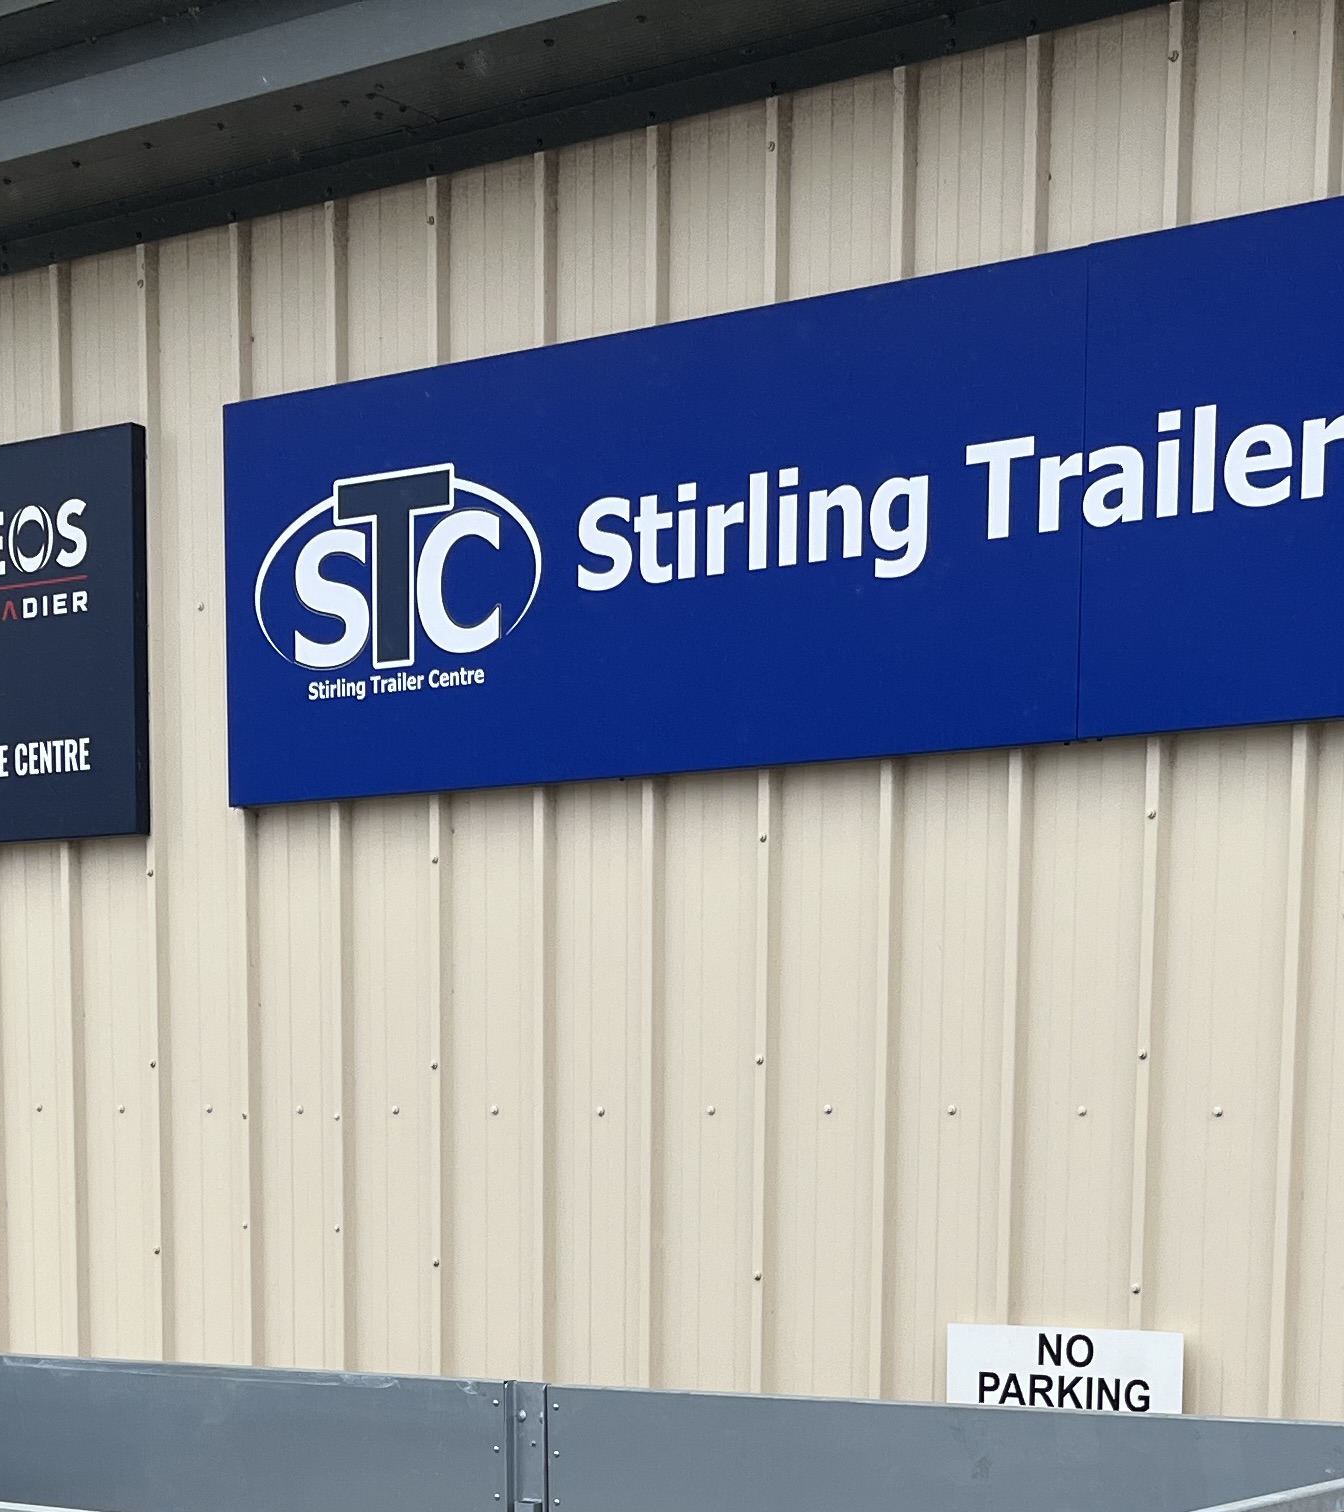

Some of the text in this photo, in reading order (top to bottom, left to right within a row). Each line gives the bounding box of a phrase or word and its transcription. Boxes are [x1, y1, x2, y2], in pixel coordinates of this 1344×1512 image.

[577, 466, 929, 578] Stirling
[294, 463, 501, 669] STC
[308, 667, 485, 700] Stirling Trailer Centre
[14, 737, 91, 776] CENTRE
[1037, 1333, 1094, 1367] NO
[978, 1371, 1150, 1412] PARKING
